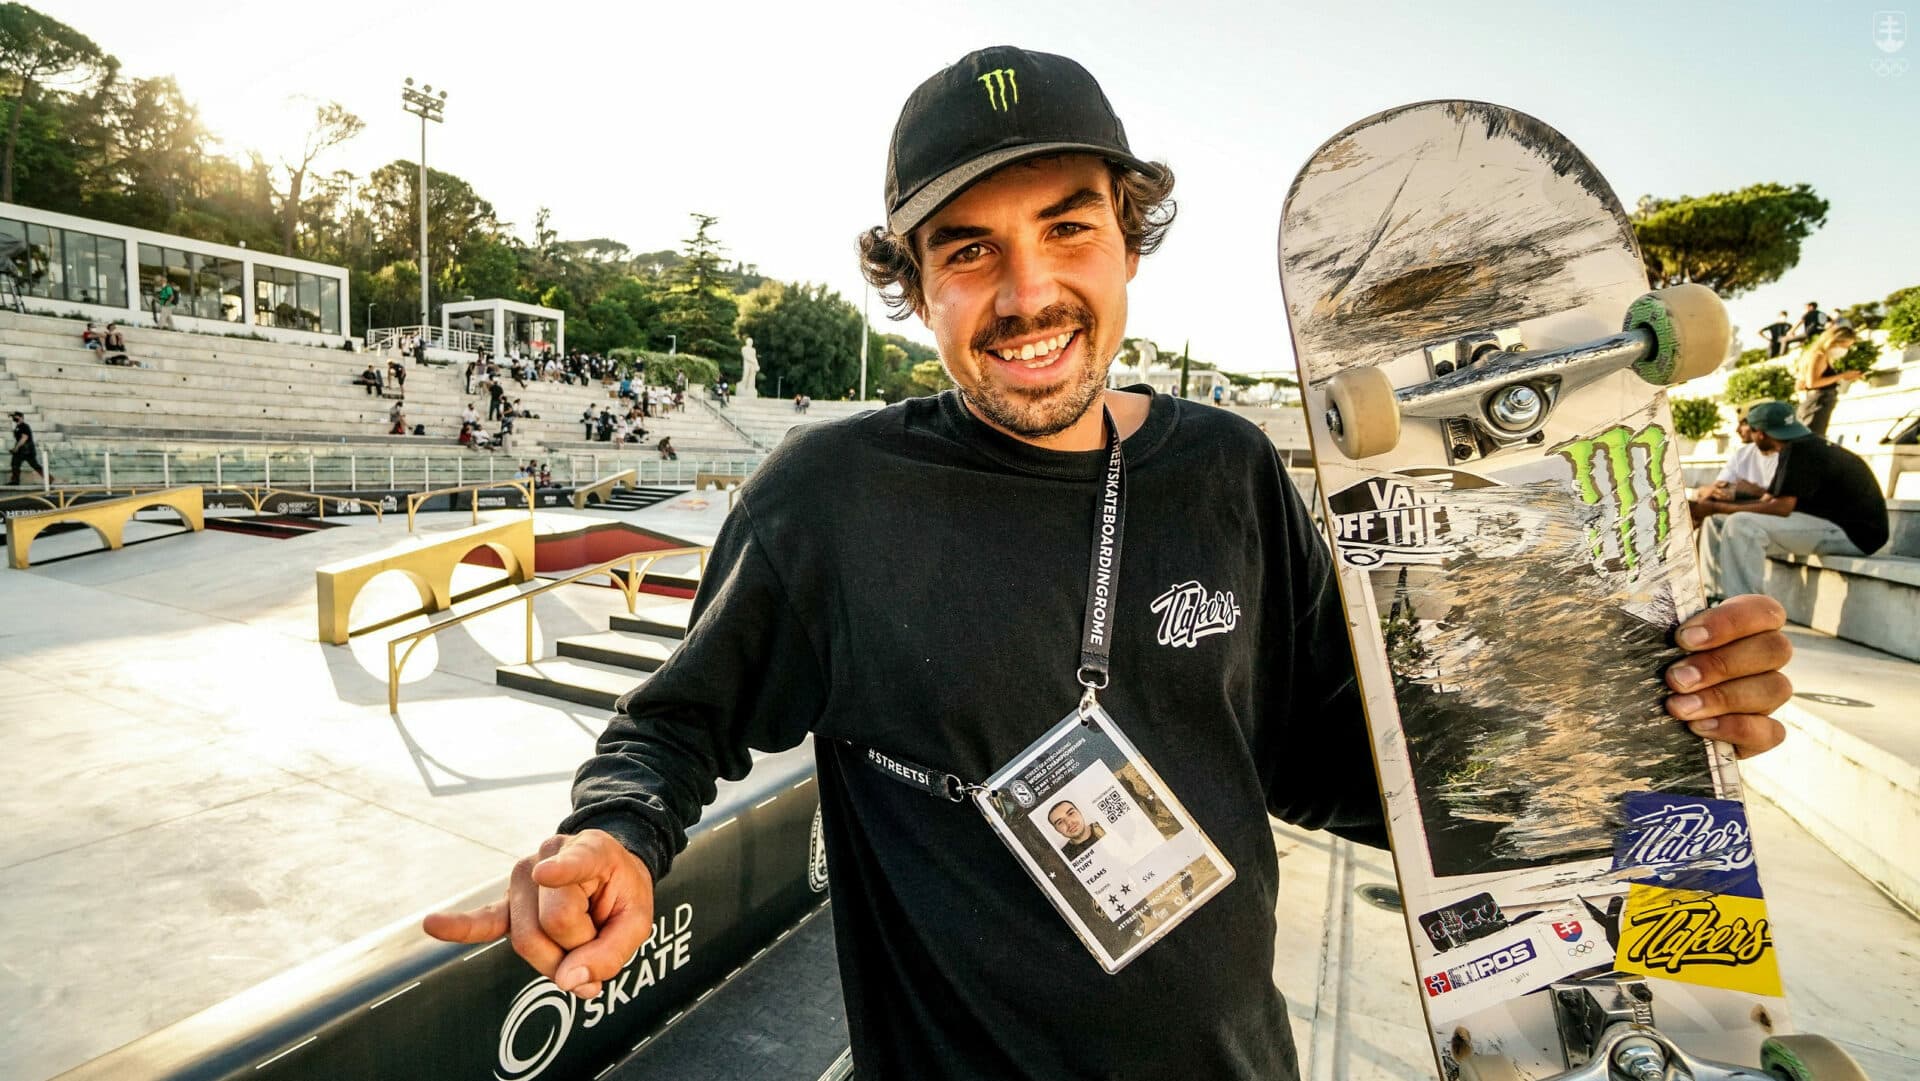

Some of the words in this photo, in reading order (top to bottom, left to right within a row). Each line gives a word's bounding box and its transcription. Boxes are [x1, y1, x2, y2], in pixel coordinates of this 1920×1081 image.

[1028, 768, 1047, 784] WORLD
[1072, 849, 1095, 868] Richard
[1076, 860, 1093, 874] TURY
[1086, 868, 1107, 886] TEAMS
[1142, 871, 1156, 883] SVK
[582, 931, 693, 1029] SKATE
